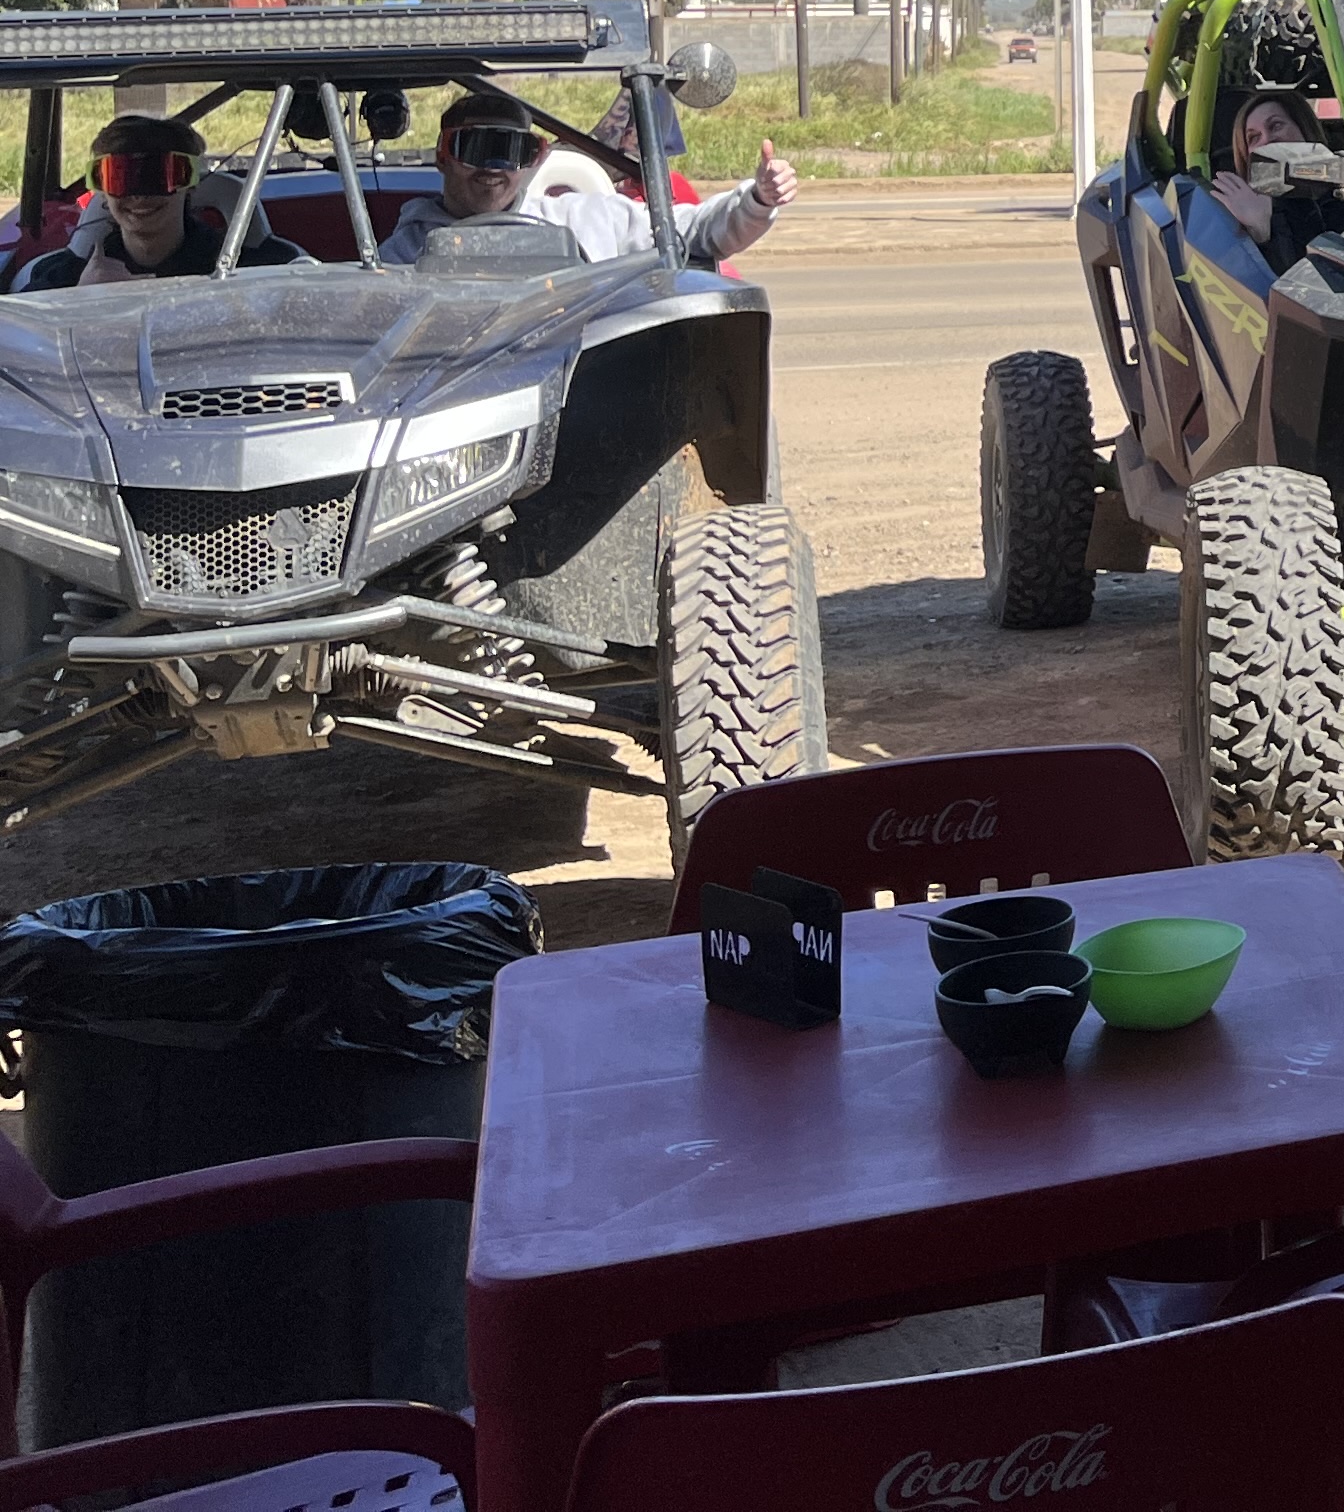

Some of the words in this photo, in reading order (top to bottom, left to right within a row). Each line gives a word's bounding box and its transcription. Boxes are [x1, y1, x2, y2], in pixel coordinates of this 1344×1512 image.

[866, 795, 1000, 852] Coca-Cola
[710, 928, 751, 966] NAP
[873, 1423, 1113, 1512] Coca-Cola
